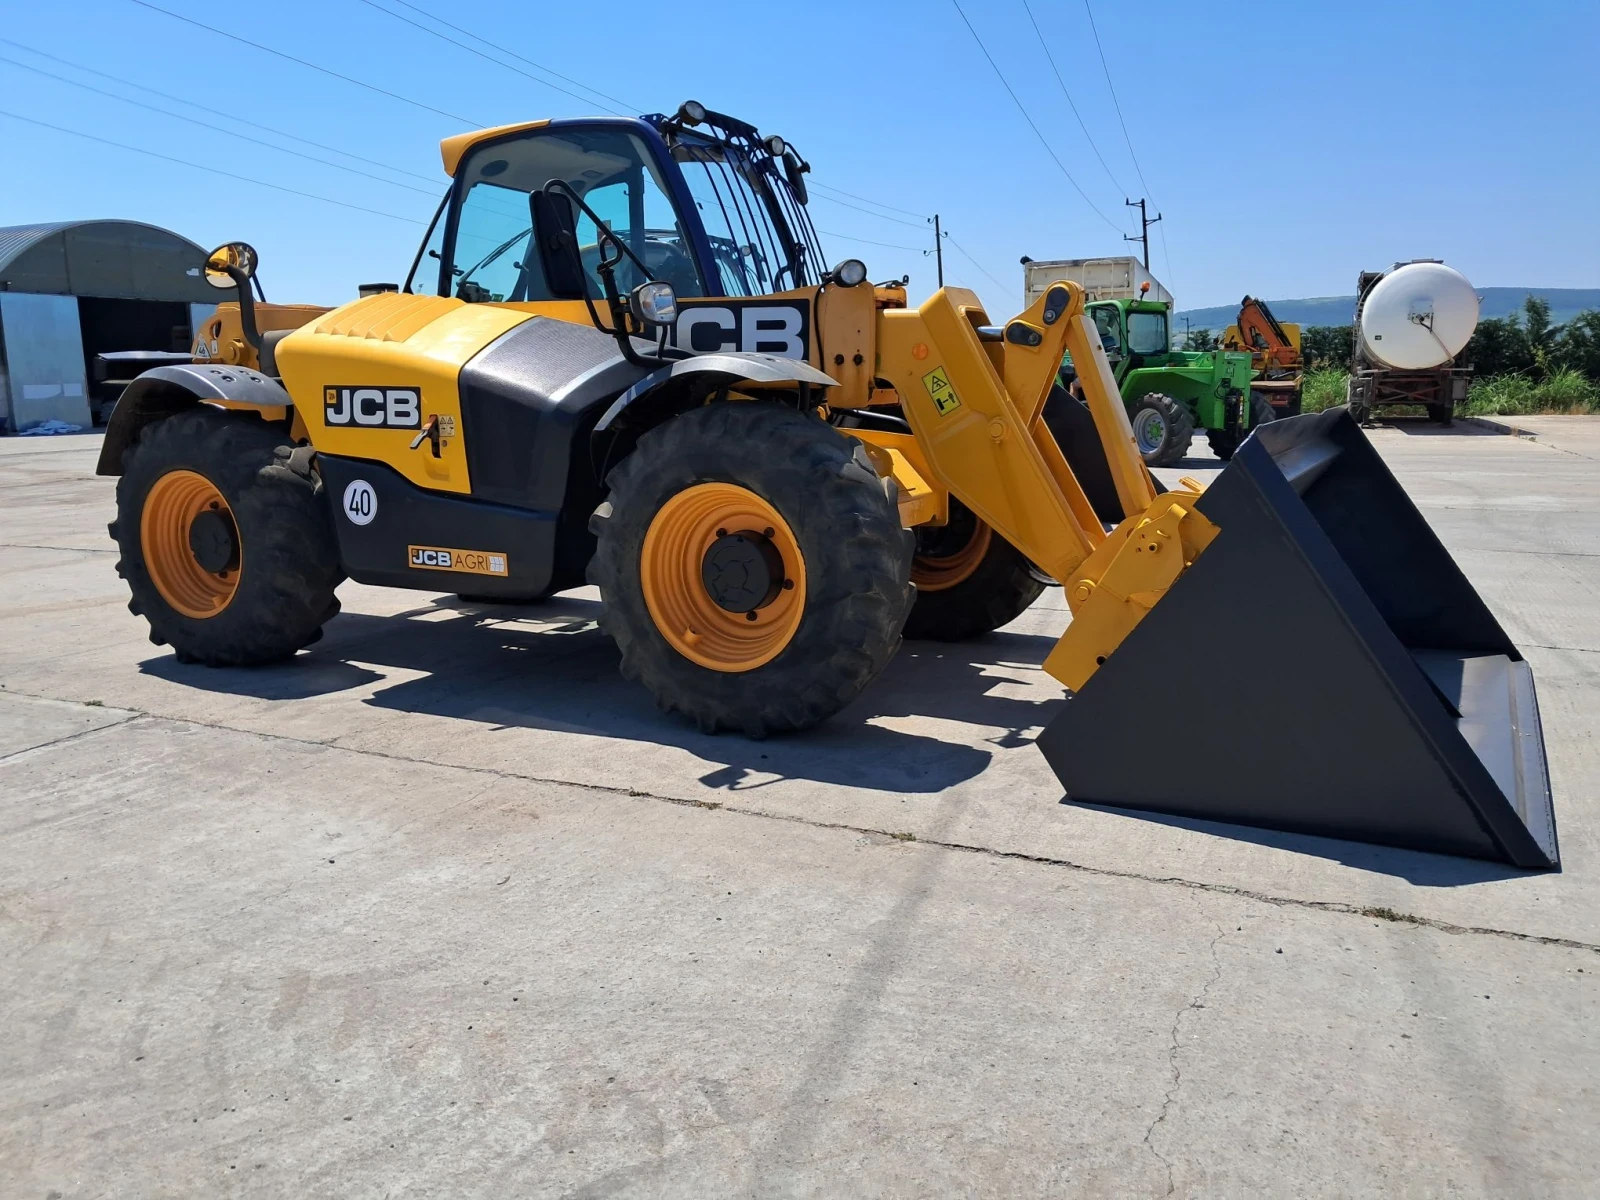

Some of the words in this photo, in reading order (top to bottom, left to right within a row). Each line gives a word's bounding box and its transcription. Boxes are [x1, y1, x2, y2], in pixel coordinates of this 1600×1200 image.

[656, 306, 804, 361] CB
[326, 389, 419, 426] JCB
[349, 488, 371, 517] 40
[412, 550, 451, 567] JCB
[454, 553, 489, 571] AGRI
